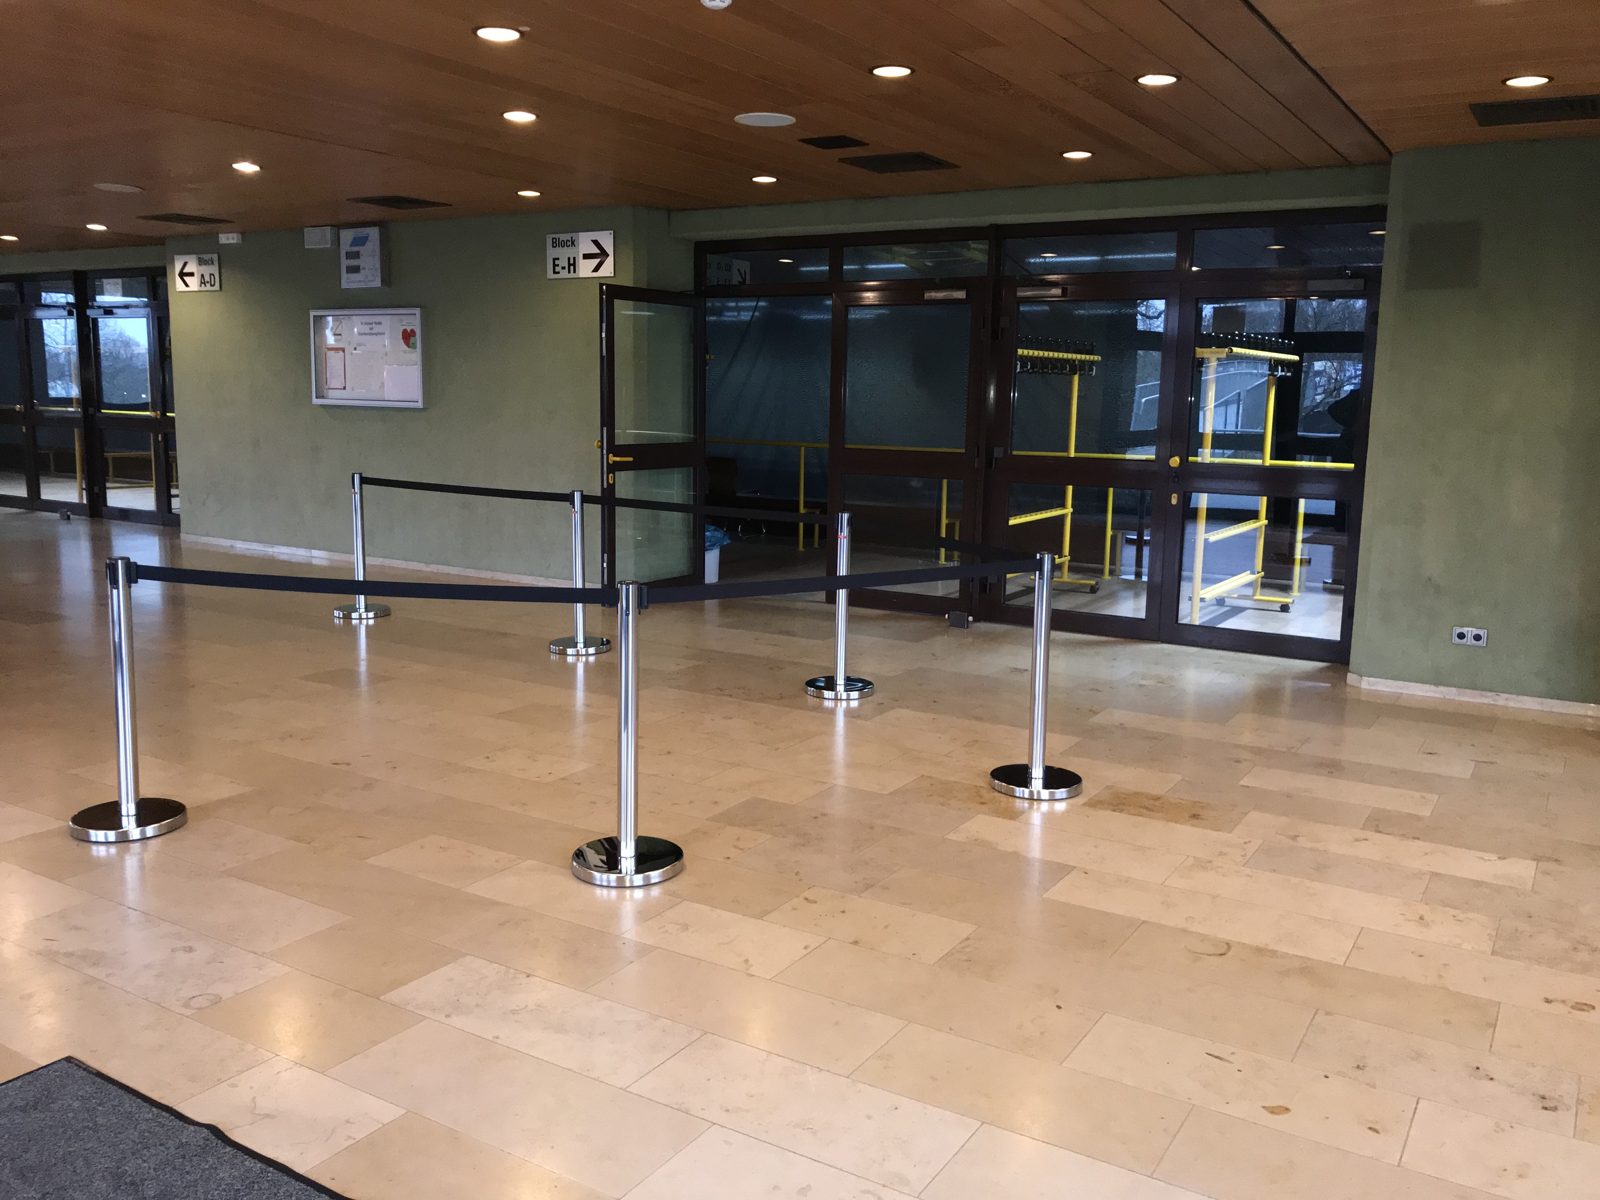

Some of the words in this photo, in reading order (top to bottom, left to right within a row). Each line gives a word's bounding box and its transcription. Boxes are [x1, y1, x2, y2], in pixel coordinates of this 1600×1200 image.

[551, 236, 576, 249] Block
[197, 256, 215, 267] Block
[552, 256, 577, 275] E-H
[199, 273, 216, 288] A-D
